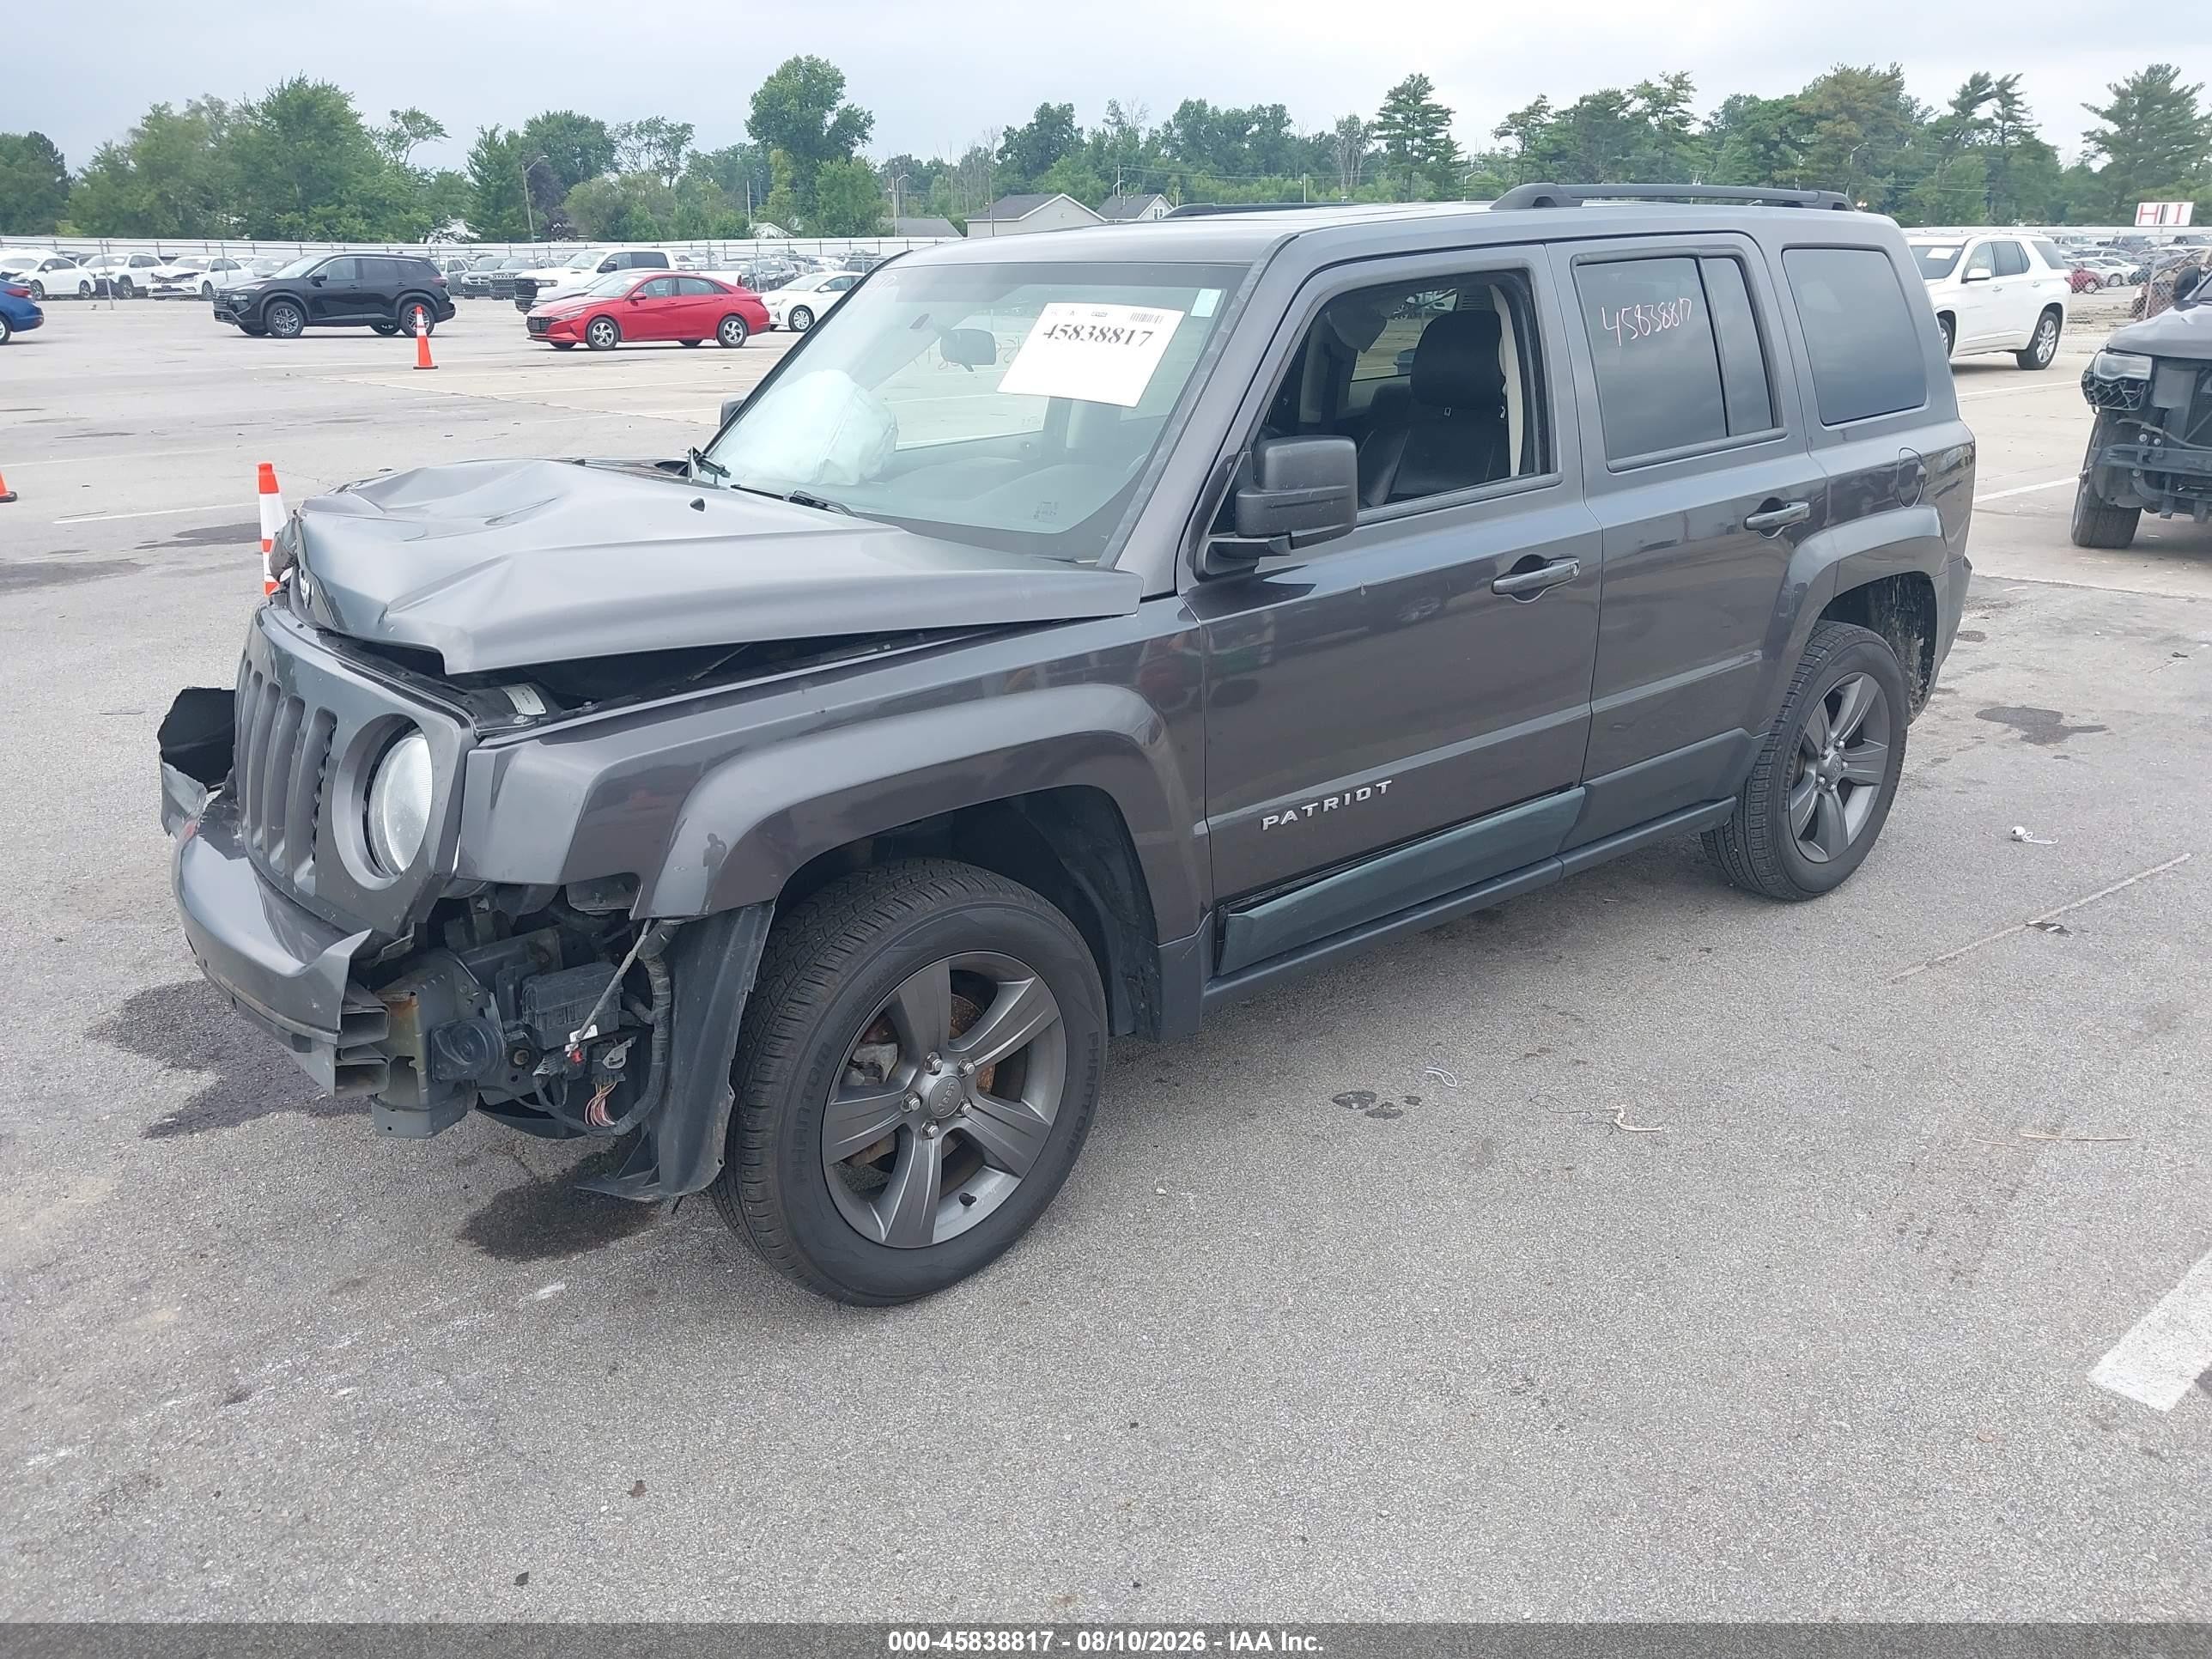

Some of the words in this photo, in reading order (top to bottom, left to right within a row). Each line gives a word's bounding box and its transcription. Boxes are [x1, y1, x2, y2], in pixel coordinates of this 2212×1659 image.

[1043, 323, 1154, 347] 45838817
[1601, 297, 1692, 346] 45838817
[1261, 780, 1392, 831] PATRIOT
